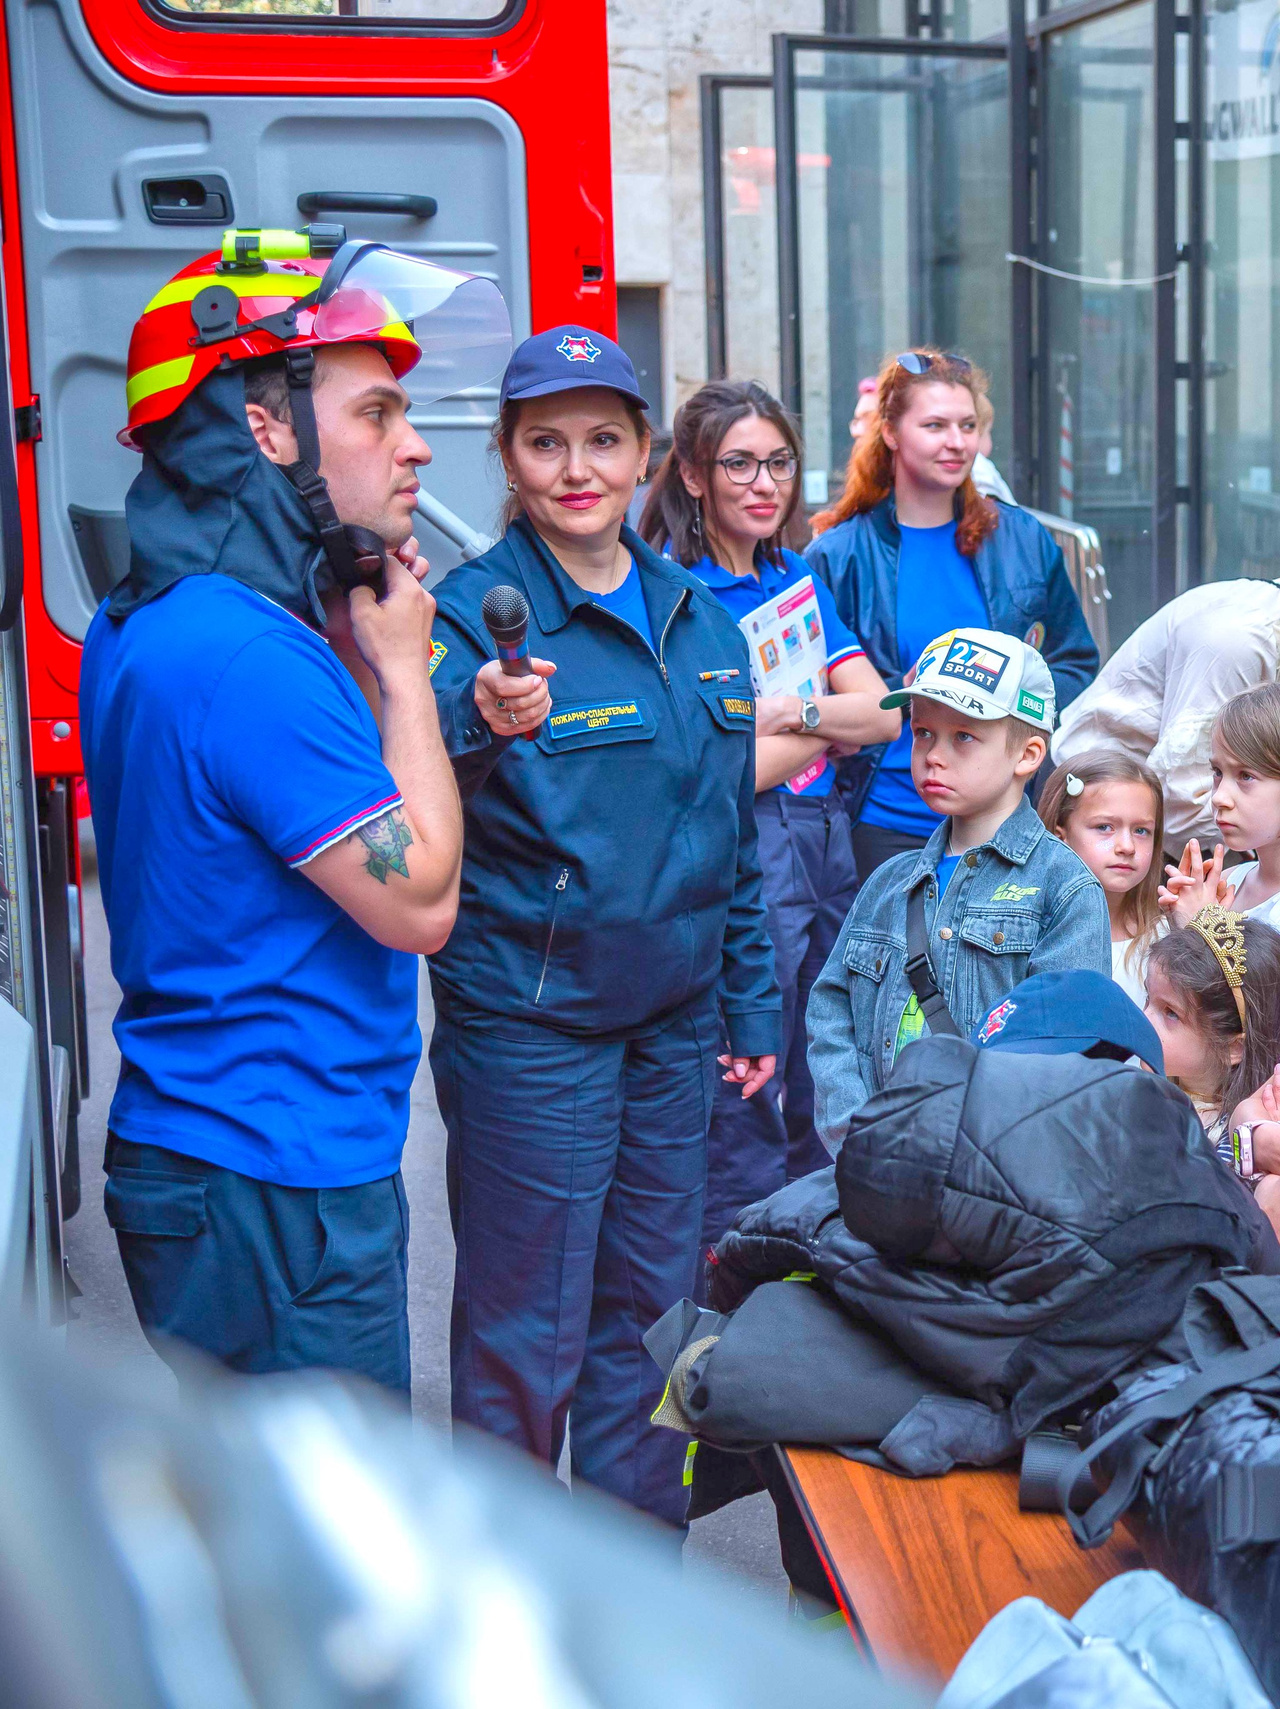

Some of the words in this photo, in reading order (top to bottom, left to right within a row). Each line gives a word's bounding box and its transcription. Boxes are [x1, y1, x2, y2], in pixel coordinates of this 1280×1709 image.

[947, 641, 985, 668] 27
[944, 663, 995, 687] SPORT
[550, 704, 638, 727] ПОЖАРНО-СПАСАТЕЛЬНЫЙ
[587, 717, 610, 728] ЦЕНТР
